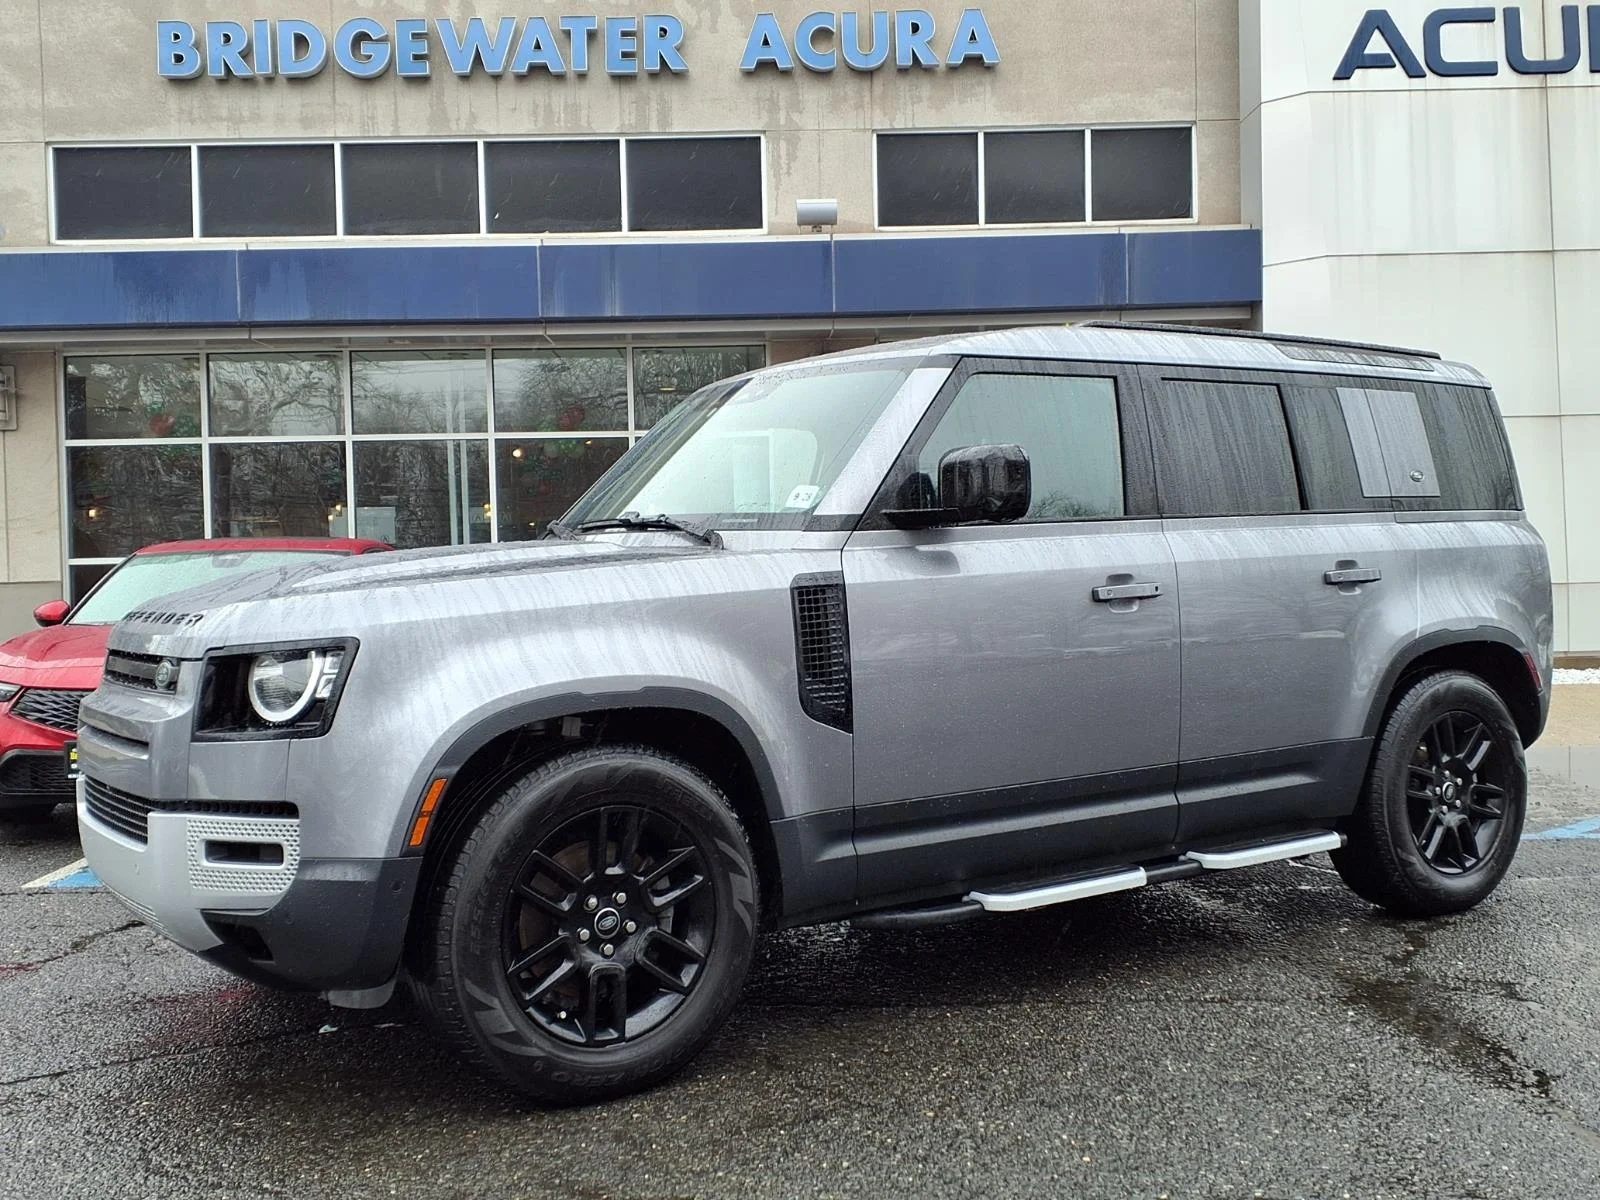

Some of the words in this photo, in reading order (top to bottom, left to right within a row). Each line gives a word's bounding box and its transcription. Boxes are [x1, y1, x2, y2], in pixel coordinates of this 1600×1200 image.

[157, 14, 689, 80] BRIDGEWATER
[739, 8, 1002, 73] ACURA
[1332, 5, 1600, 80] ACU
